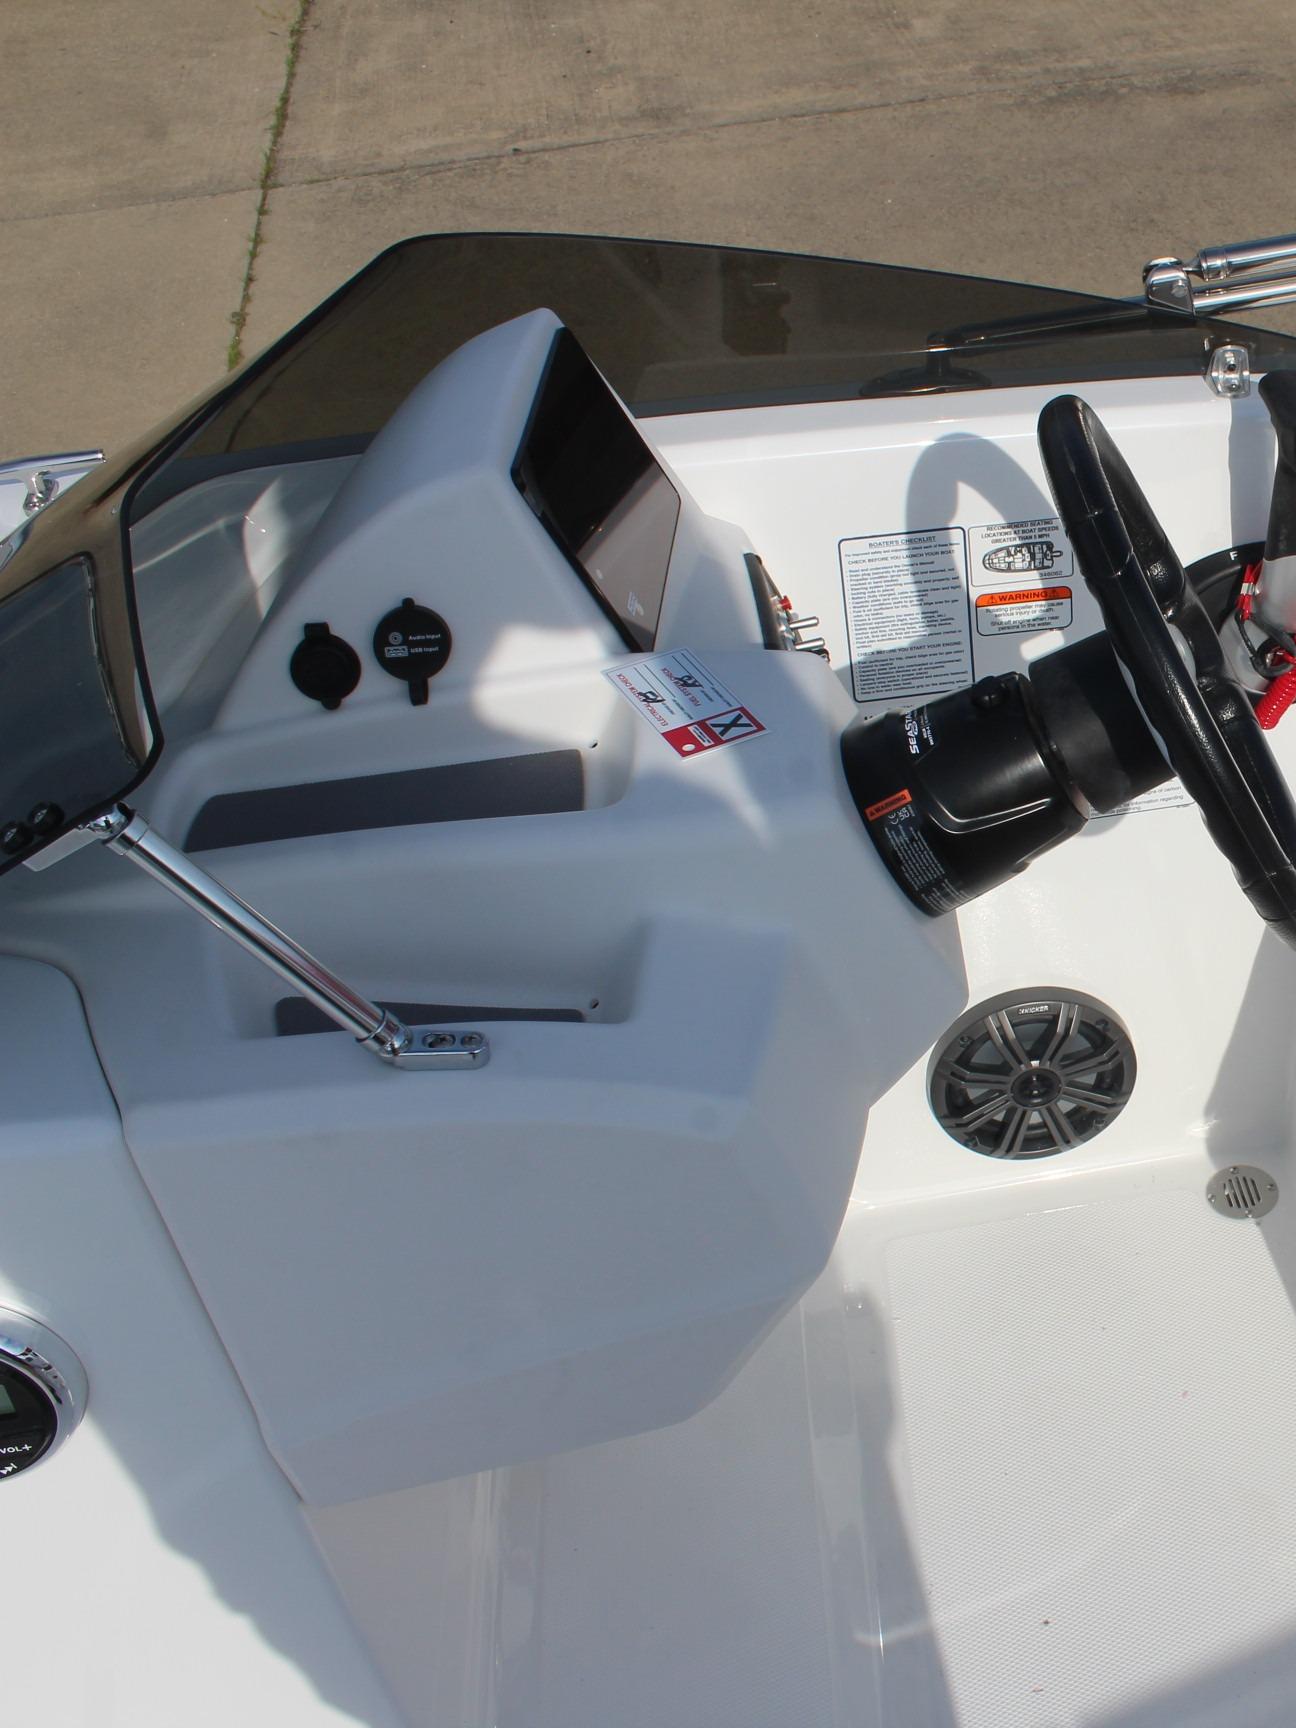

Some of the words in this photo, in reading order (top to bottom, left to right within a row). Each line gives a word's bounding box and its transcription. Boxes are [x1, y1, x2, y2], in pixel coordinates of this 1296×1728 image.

[981, 530, 1013, 539] LOCATIONS
[1021, 527, 1037, 535] BOAT
[1037, 525, 1059, 533] SPEEDS
[986, 521, 1029, 532] RECOMMENDED
[1029, 520, 1053, 528] SEATING
[868, 540, 900, 549] BOATER'S
[900, 535, 936, 545] CHECKLIST
[991, 536, 1018, 545] GREATER
[1018, 534, 1033, 542] THAN
[902, 552, 925, 560] LAUNCH
[1230, 551, 1238, 560] F
[998, 590, 1048, 602] WARNING
[857, 649, 877, 657] CHECK
[877, 648, 897, 656] BEFORE
[909, 644, 927, 652] START
[644, 702, 669, 726] ELECTRICAL
[1025, 1004, 1049, 1015] KICKER
